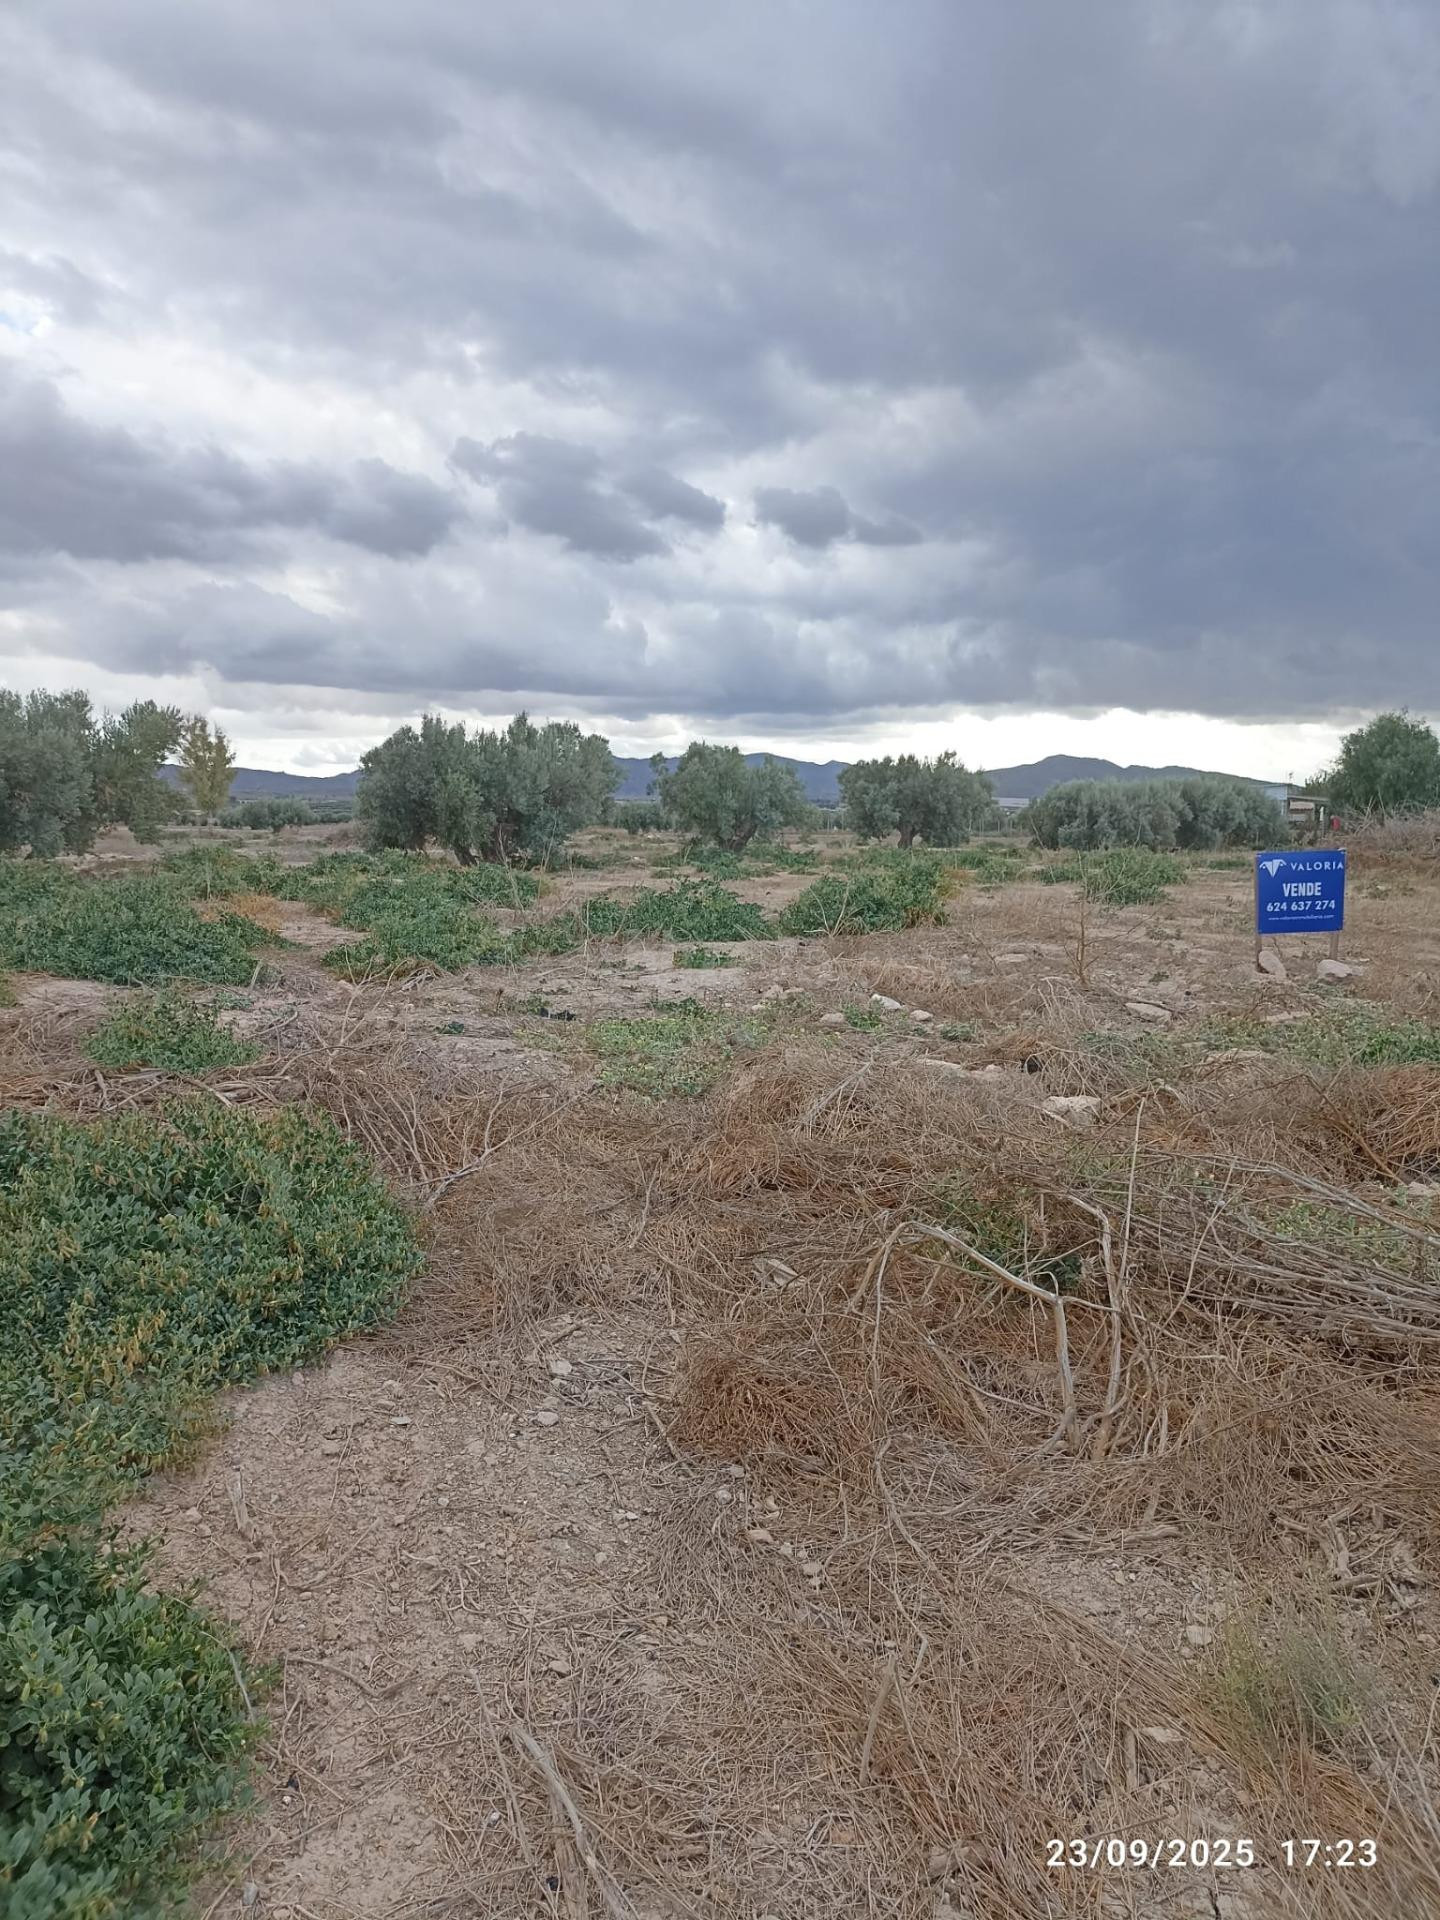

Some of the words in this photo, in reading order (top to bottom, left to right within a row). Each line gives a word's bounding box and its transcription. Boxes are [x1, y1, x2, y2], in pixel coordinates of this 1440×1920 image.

[1290, 861, 1344, 871] VALORIA
[1282, 882, 1322, 897] VENDE
[1266, 902, 1287, 912] 624
[1290, 901, 1312, 911] 637
[1315, 900, 1335, 910] 274
